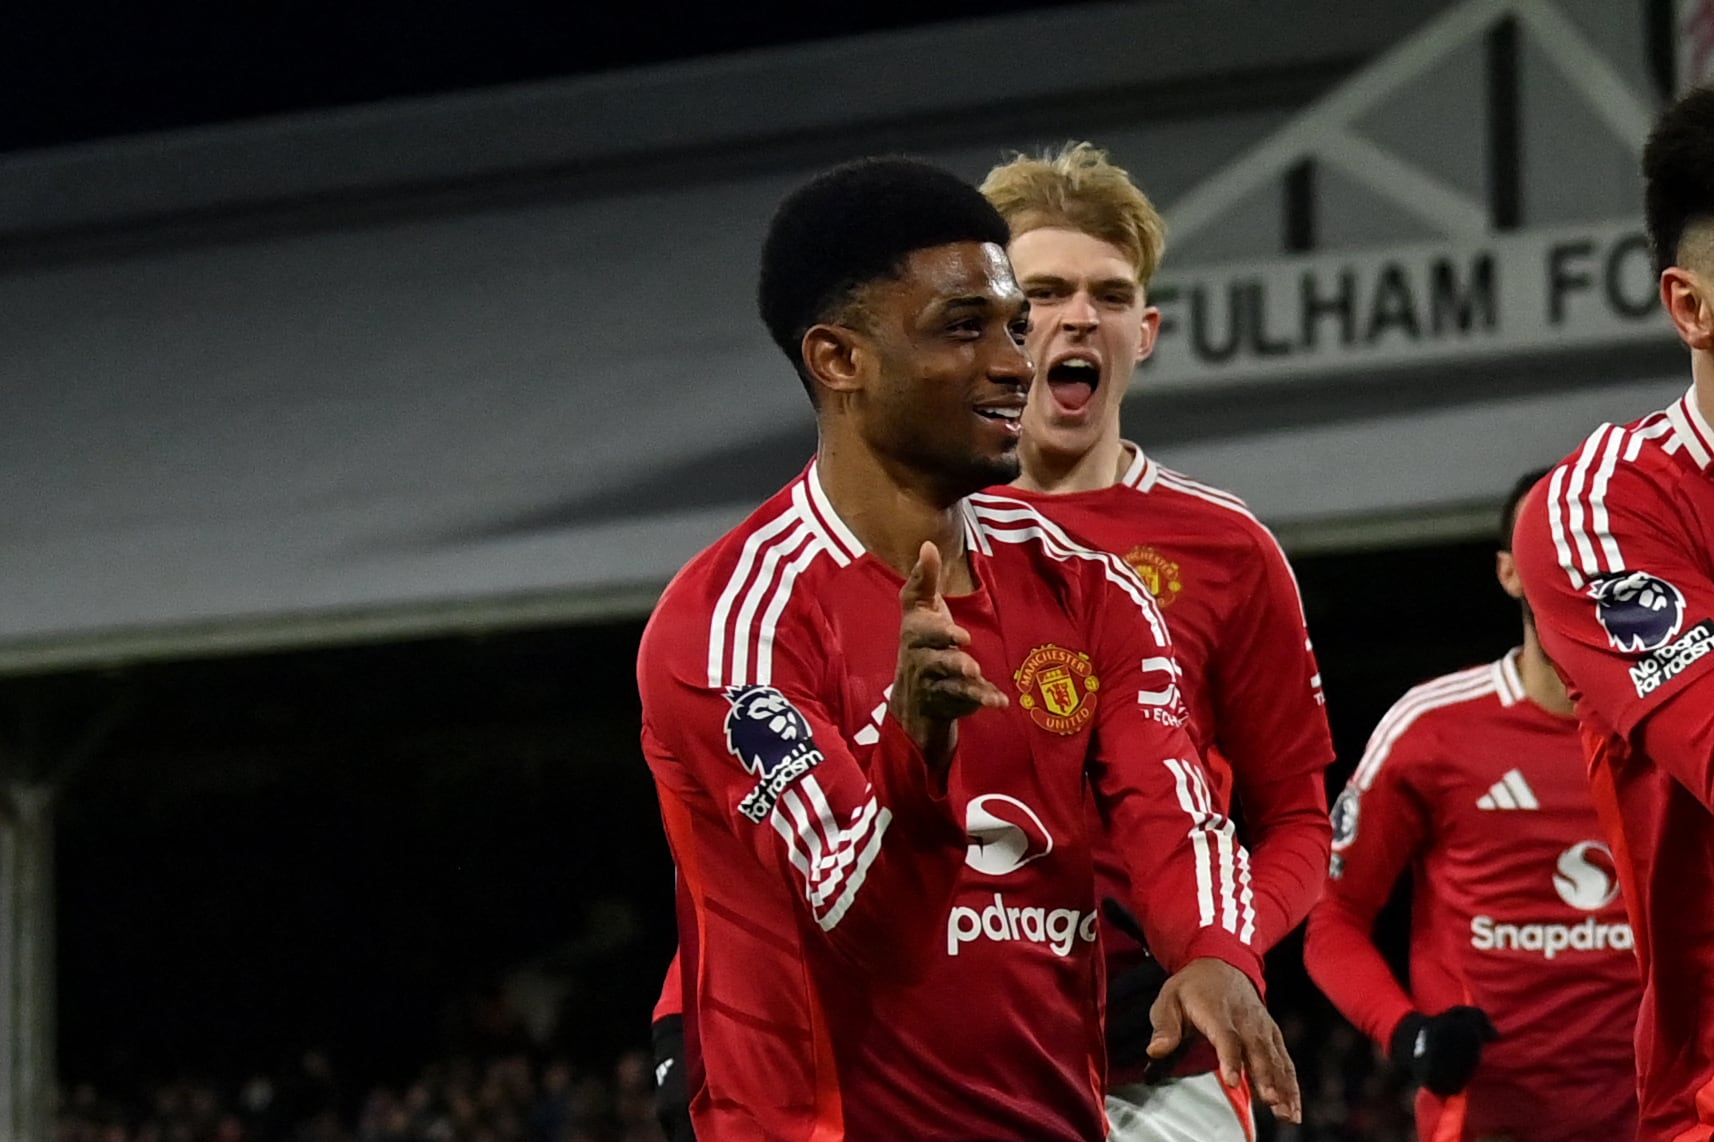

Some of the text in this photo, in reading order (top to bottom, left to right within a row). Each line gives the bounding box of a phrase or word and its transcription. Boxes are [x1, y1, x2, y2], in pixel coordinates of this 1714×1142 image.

[1020, 650, 1086, 687] MANCHESTER
[1629, 659, 1659, 687] No
[1045, 707, 1091, 730] UNITED
